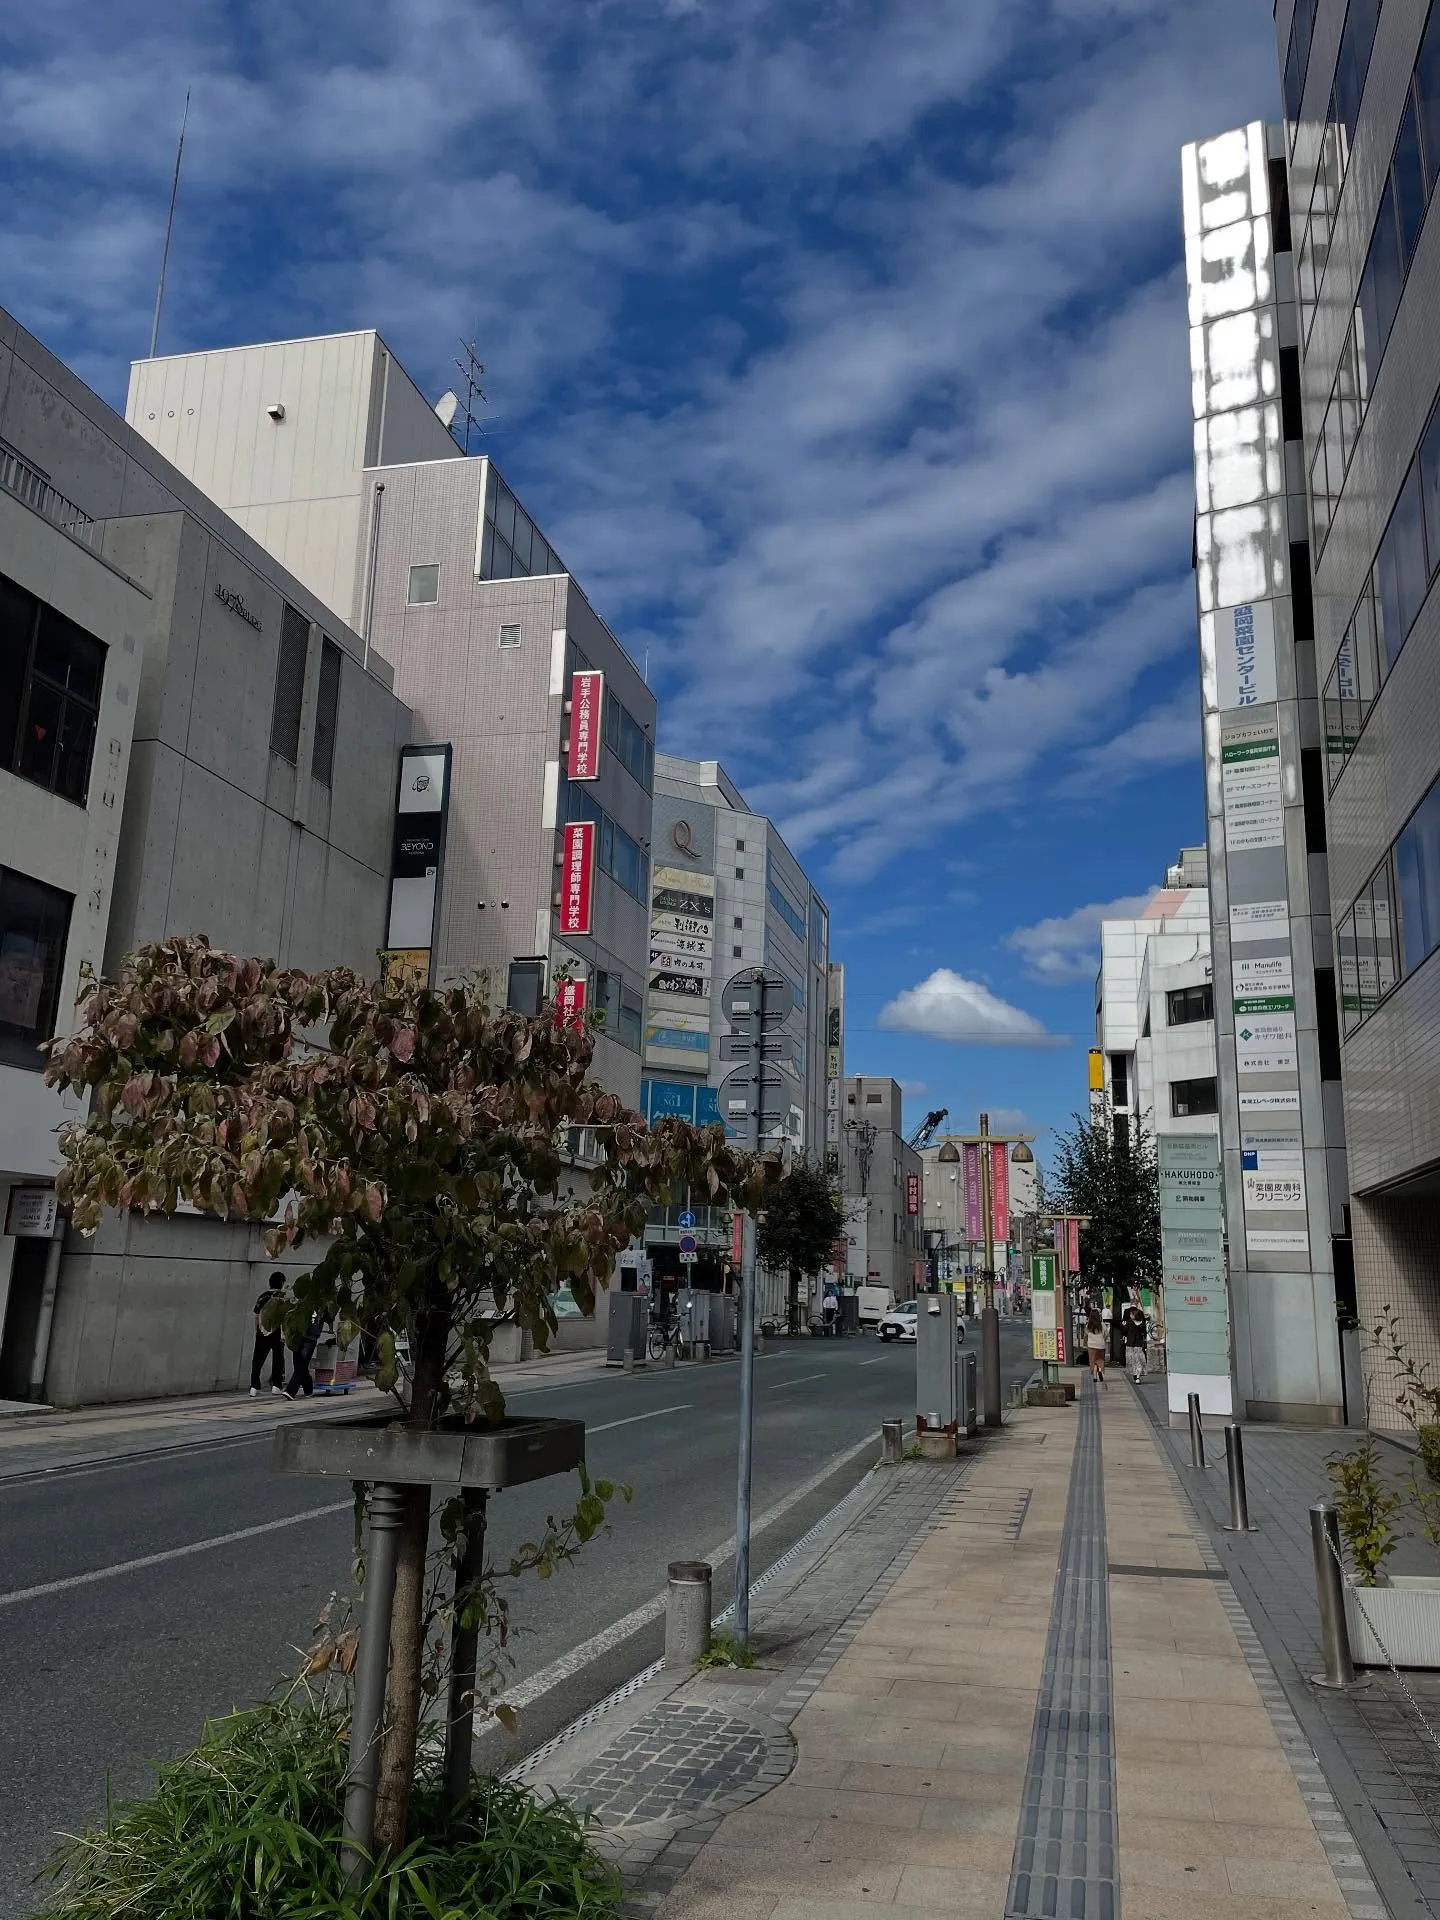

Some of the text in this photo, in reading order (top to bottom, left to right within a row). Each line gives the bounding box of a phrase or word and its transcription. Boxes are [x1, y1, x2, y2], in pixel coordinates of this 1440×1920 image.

[1234, 605, 1257, 706] 盛岡菜園センタービル
[576, 677, 592, 775] 岩手公務員専門学校
[400, 842, 435, 851] BEYOND
[568, 827, 584, 929] 菜園調理師専門学校
[1254, 961, 1283, 970] Manulife
[1164, 1171, 1215, 1179] HAKUHODO
[1255, 1183, 1301, 1192] 菜園皮膚科
[1255, 1192, 1301, 1202] クリニック
